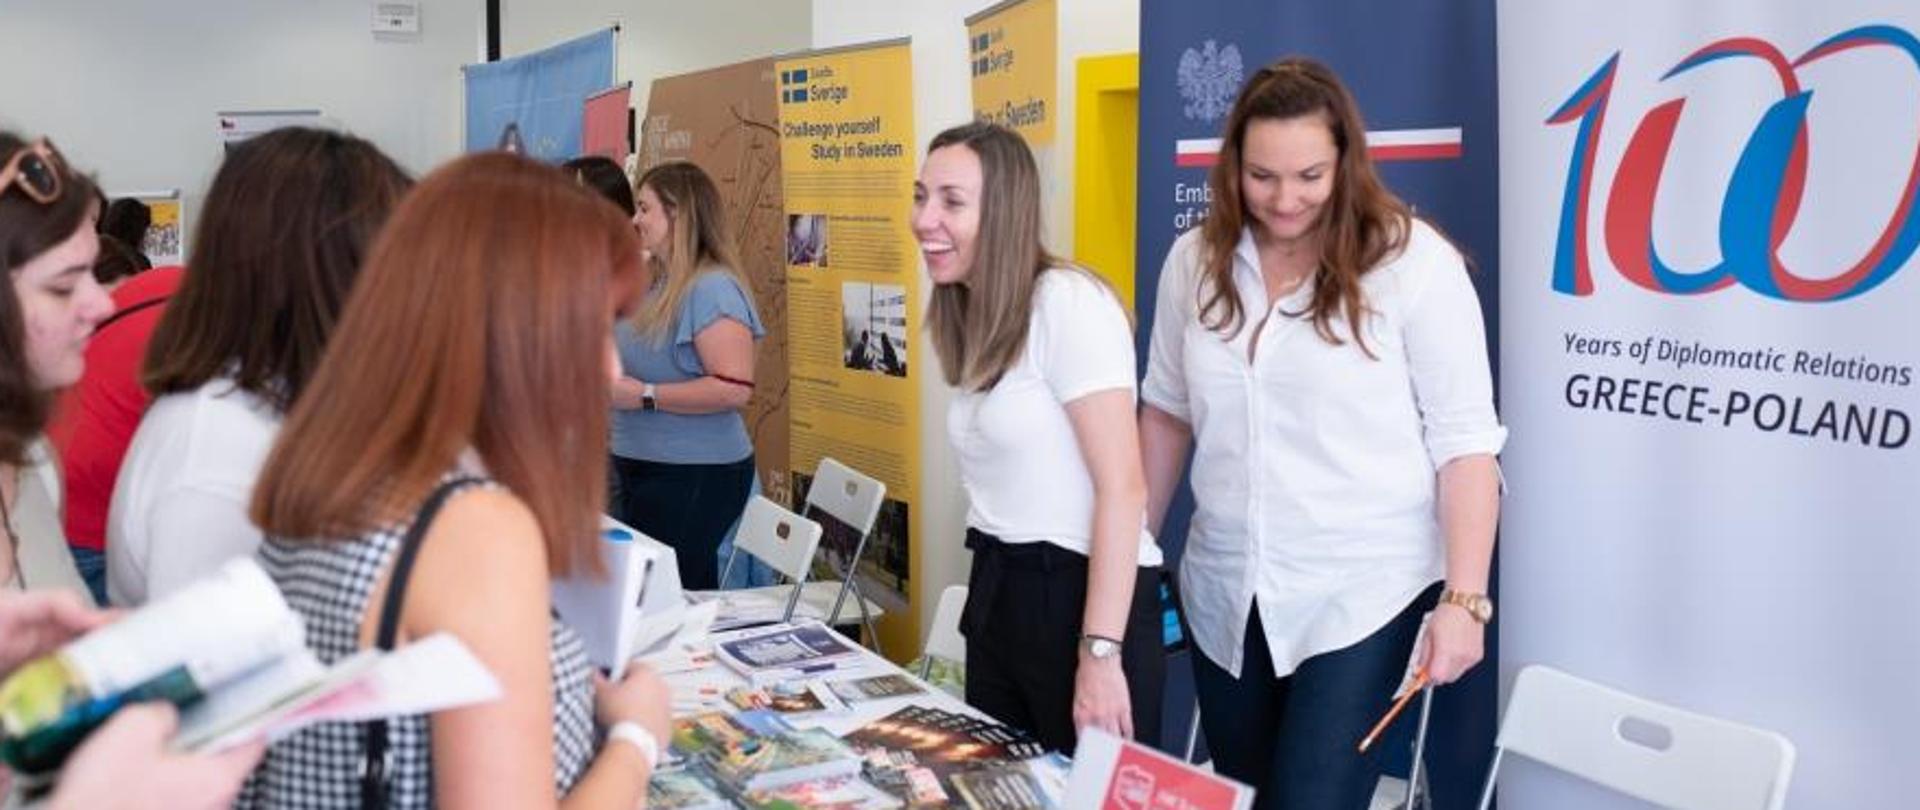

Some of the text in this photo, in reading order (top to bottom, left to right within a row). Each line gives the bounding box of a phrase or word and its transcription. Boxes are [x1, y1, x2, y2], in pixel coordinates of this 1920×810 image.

[811, 85, 848, 104] Sverige
[783, 116, 880, 140] Challenge yourself
[811, 141, 902, 162] Study in Sweden
[1545, 24, 1920, 302] 100
[1175, 181, 1214, 202] Emb
[1175, 207, 1194, 228] of
[1563, 333, 1913, 387] Years of Diplomatic Relations
[1564, 374, 1913, 450] GREECE-POLAND
